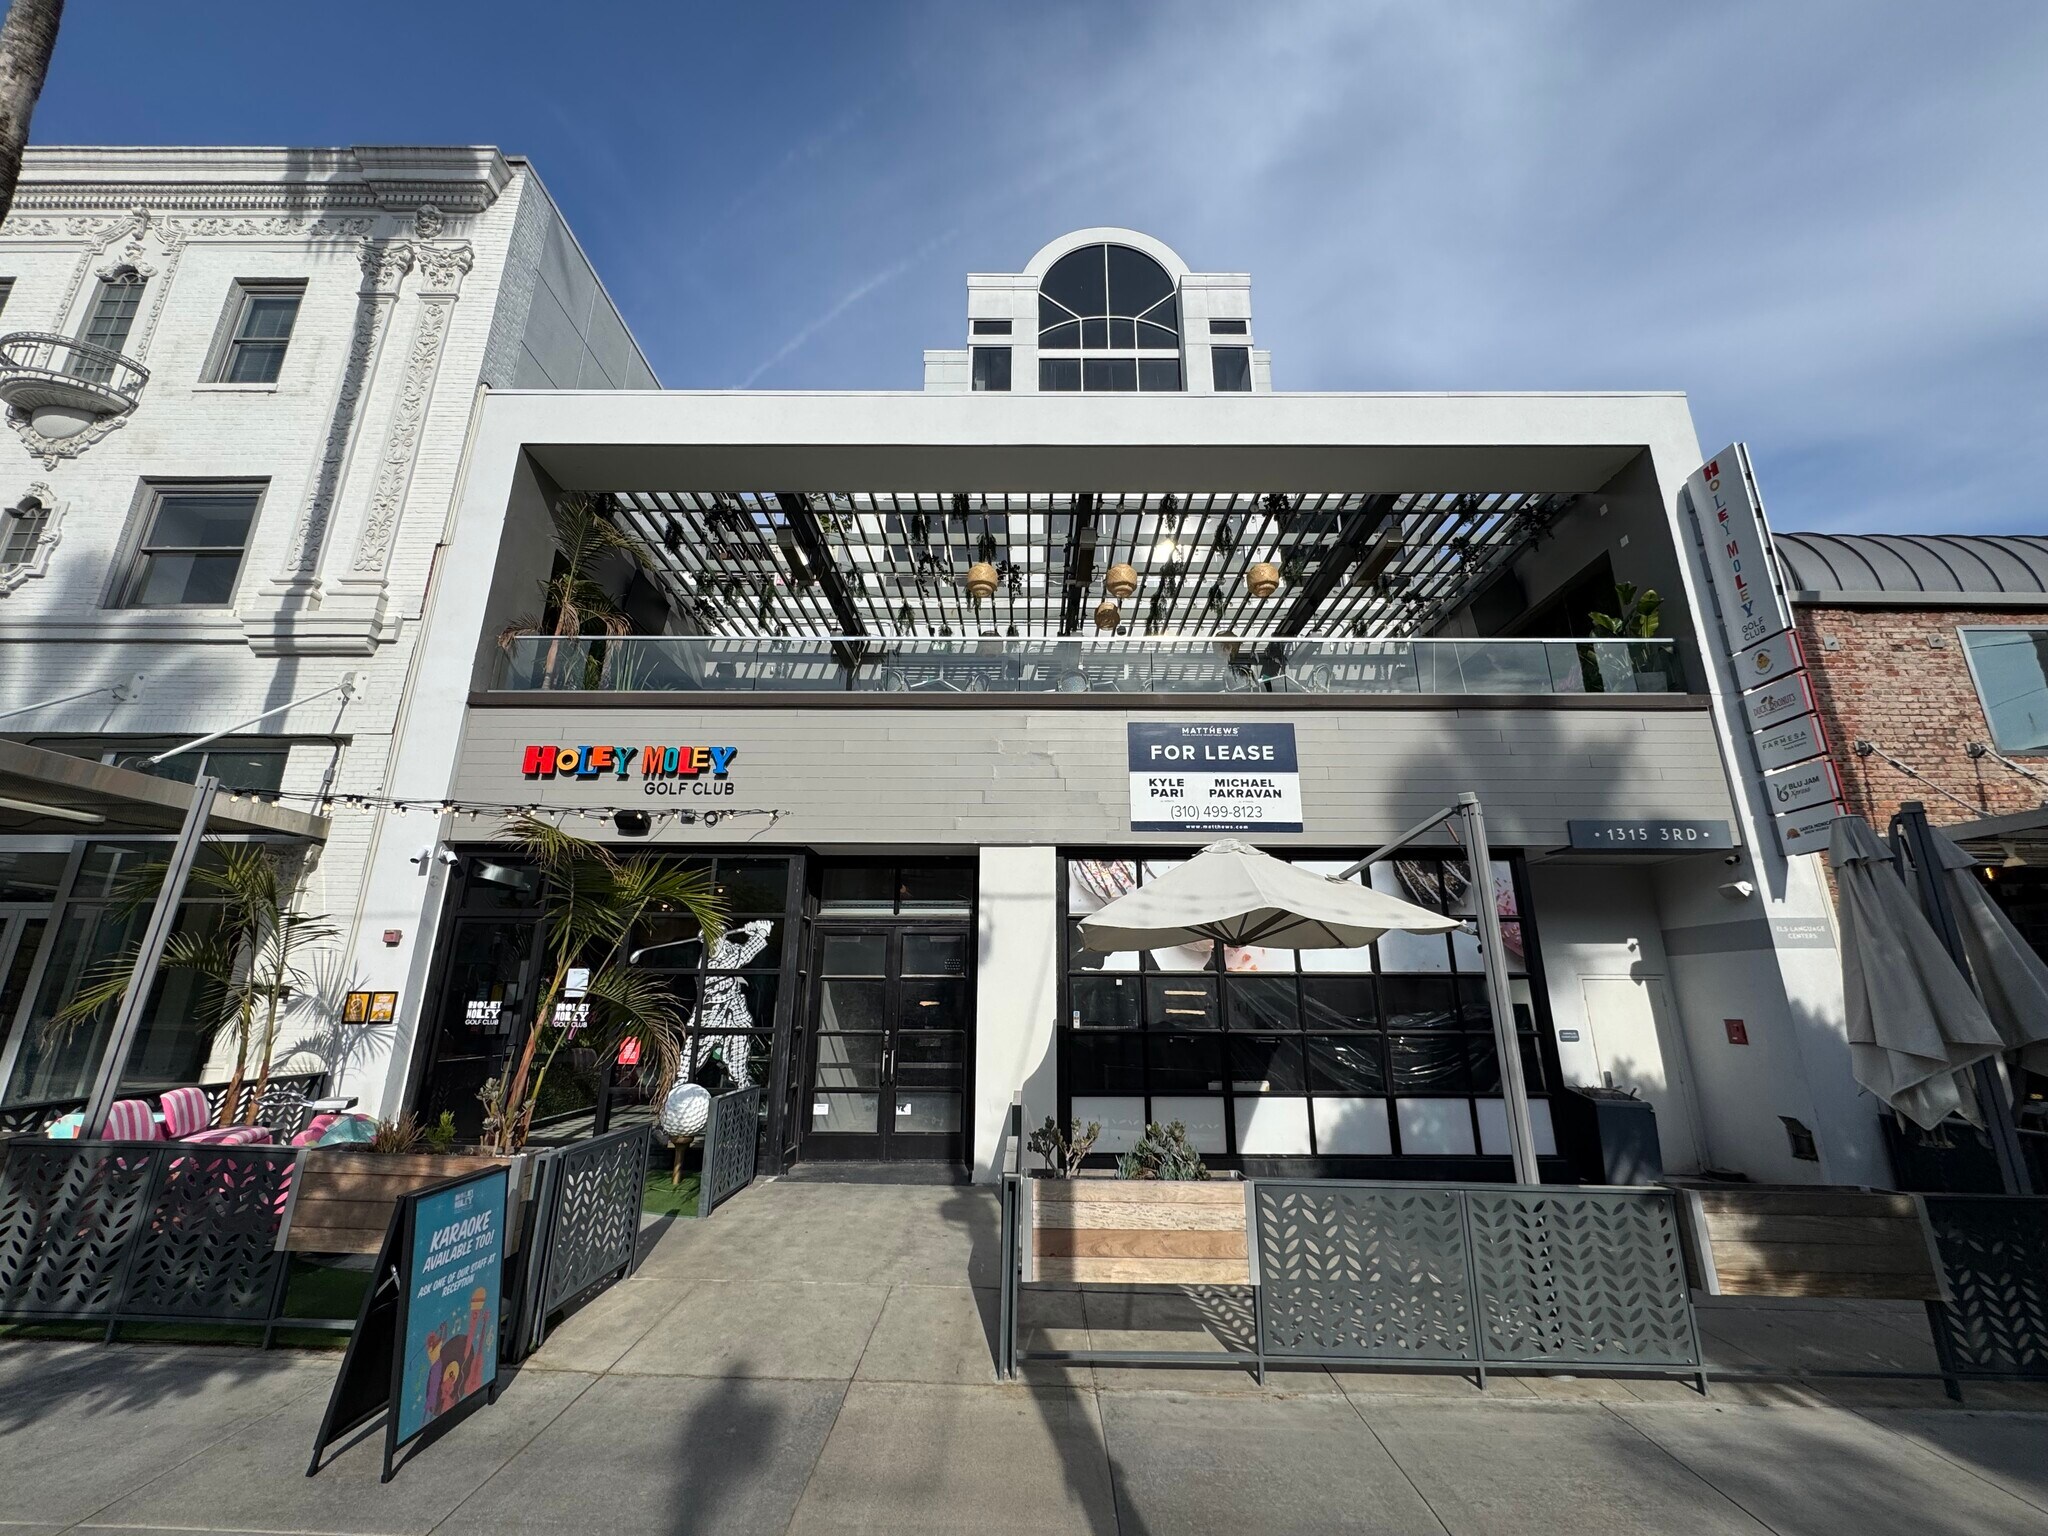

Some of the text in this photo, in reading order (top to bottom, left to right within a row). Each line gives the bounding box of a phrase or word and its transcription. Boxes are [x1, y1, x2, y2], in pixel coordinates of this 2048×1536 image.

[1703, 460, 1753, 618] HOLEY MOLEY
[1742, 617, 1764, 633] GOLF
[1744, 625, 1766, 641] CLUB
[1753, 704, 1769, 716] DUCK
[1181, 726, 1239, 734] MATTHEWS
[1762, 731, 1807, 750] FARMESA
[1150, 745, 1275, 760] FOR LEASE
[522, 745, 739, 777] HOLEY MOLEY
[644, 782, 735, 795] GOLF CLUB
[1149, 778, 1185, 787] KYLE
[1214, 779, 1275, 788] MICHAEL
[1788, 776, 1820, 790] BLU JAM
[1150, 789, 1184, 798] PARI
[1209, 789, 1282, 798] PAKRAVAN
[1170, 805, 1263, 820] (310) 499-8123
[1607, 828, 1698, 841] 1315 3RD
[468, 1001, 502, 1009] HOLEY
[466, 1009, 501, 1019] MOLEY
[430, 1209, 492, 1253] KARAOKE
[422, 1229, 495, 1274] AVAILABLE TOO!
[417, 1253, 496, 1298] ASK ONE OF OUR STAFF AT
[441, 1273, 475, 1297] RECEPTION
